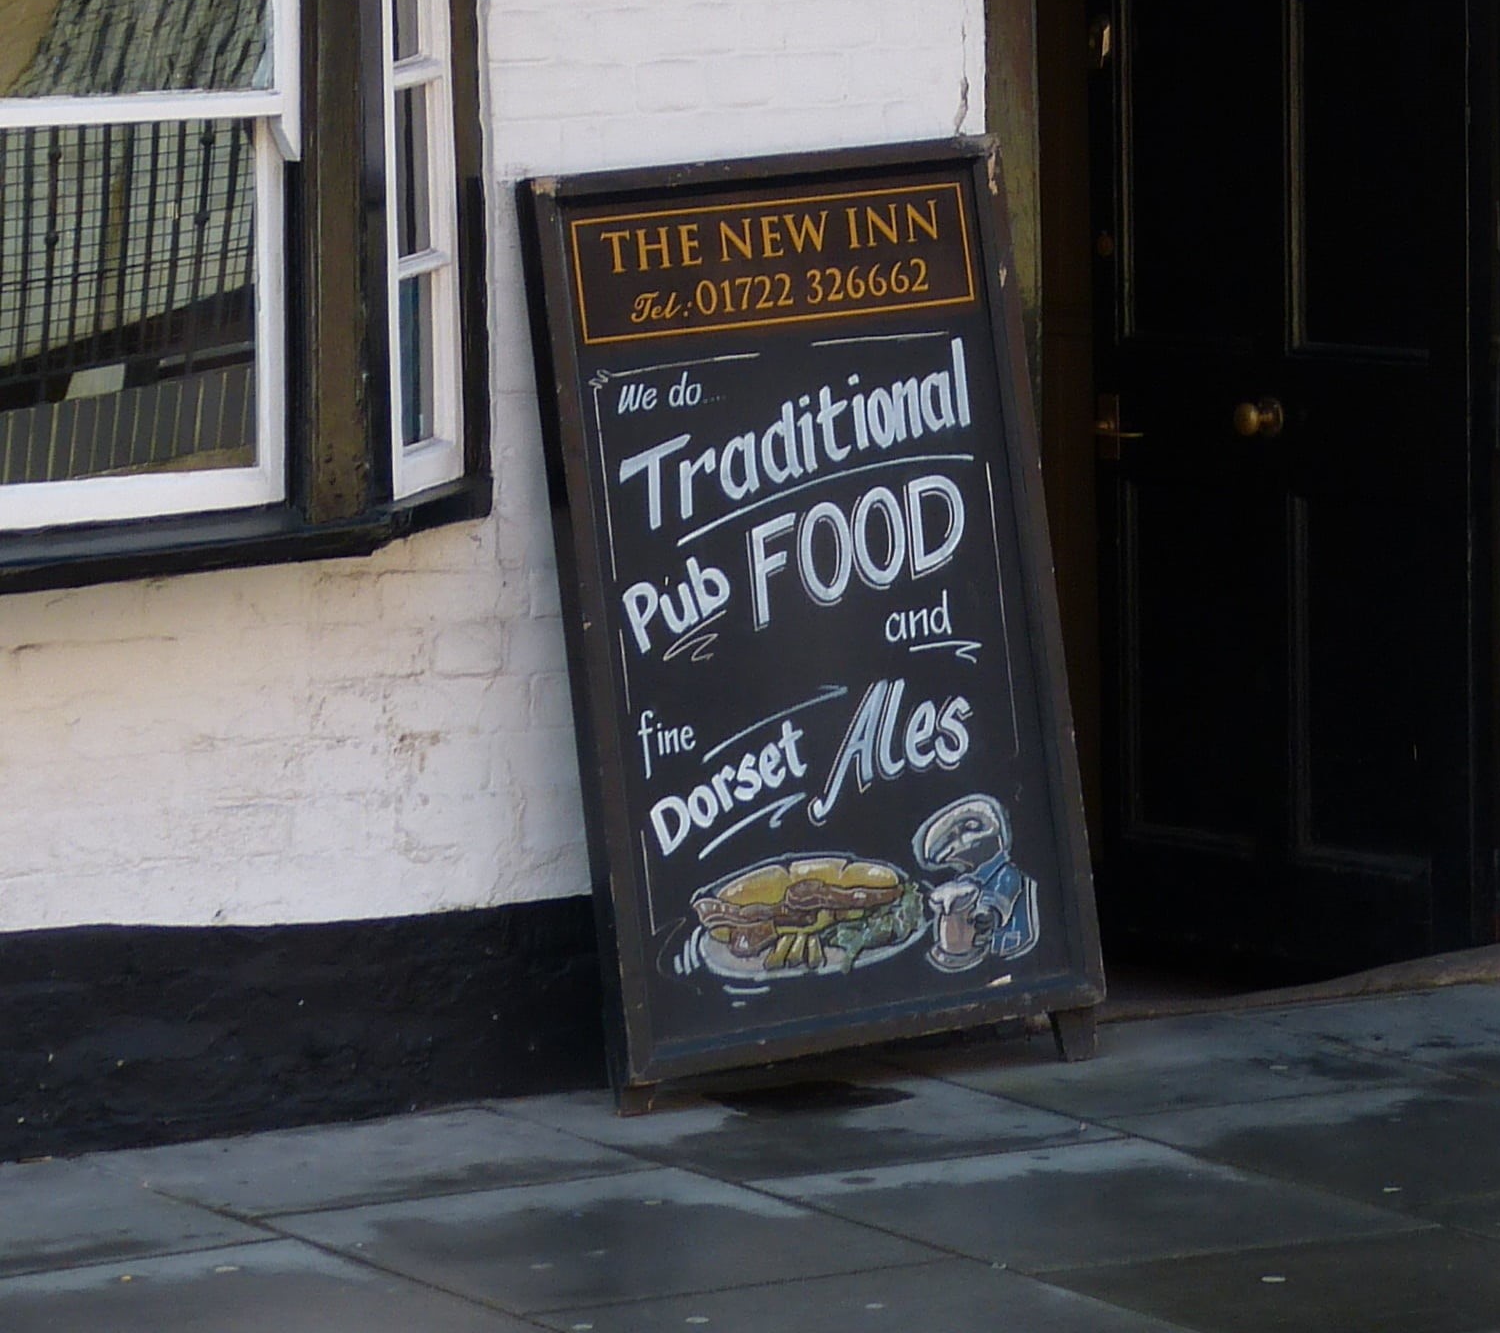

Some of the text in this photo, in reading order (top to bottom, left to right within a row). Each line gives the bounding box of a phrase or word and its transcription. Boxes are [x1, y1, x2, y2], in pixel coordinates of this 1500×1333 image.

[601, 200, 939, 274] THE NEW INN
[695, 273, 794, 315] 01722
[805, 257, 929, 304] 326662
[618, 383, 658, 414] We
[619, 337, 972, 531] Traditional
[621, 474, 966, 655] Pub FOOD
[884, 589, 953, 642] and
[637, 709, 697, 780] fine
[650, 678, 974, 857] Dorset Ales
